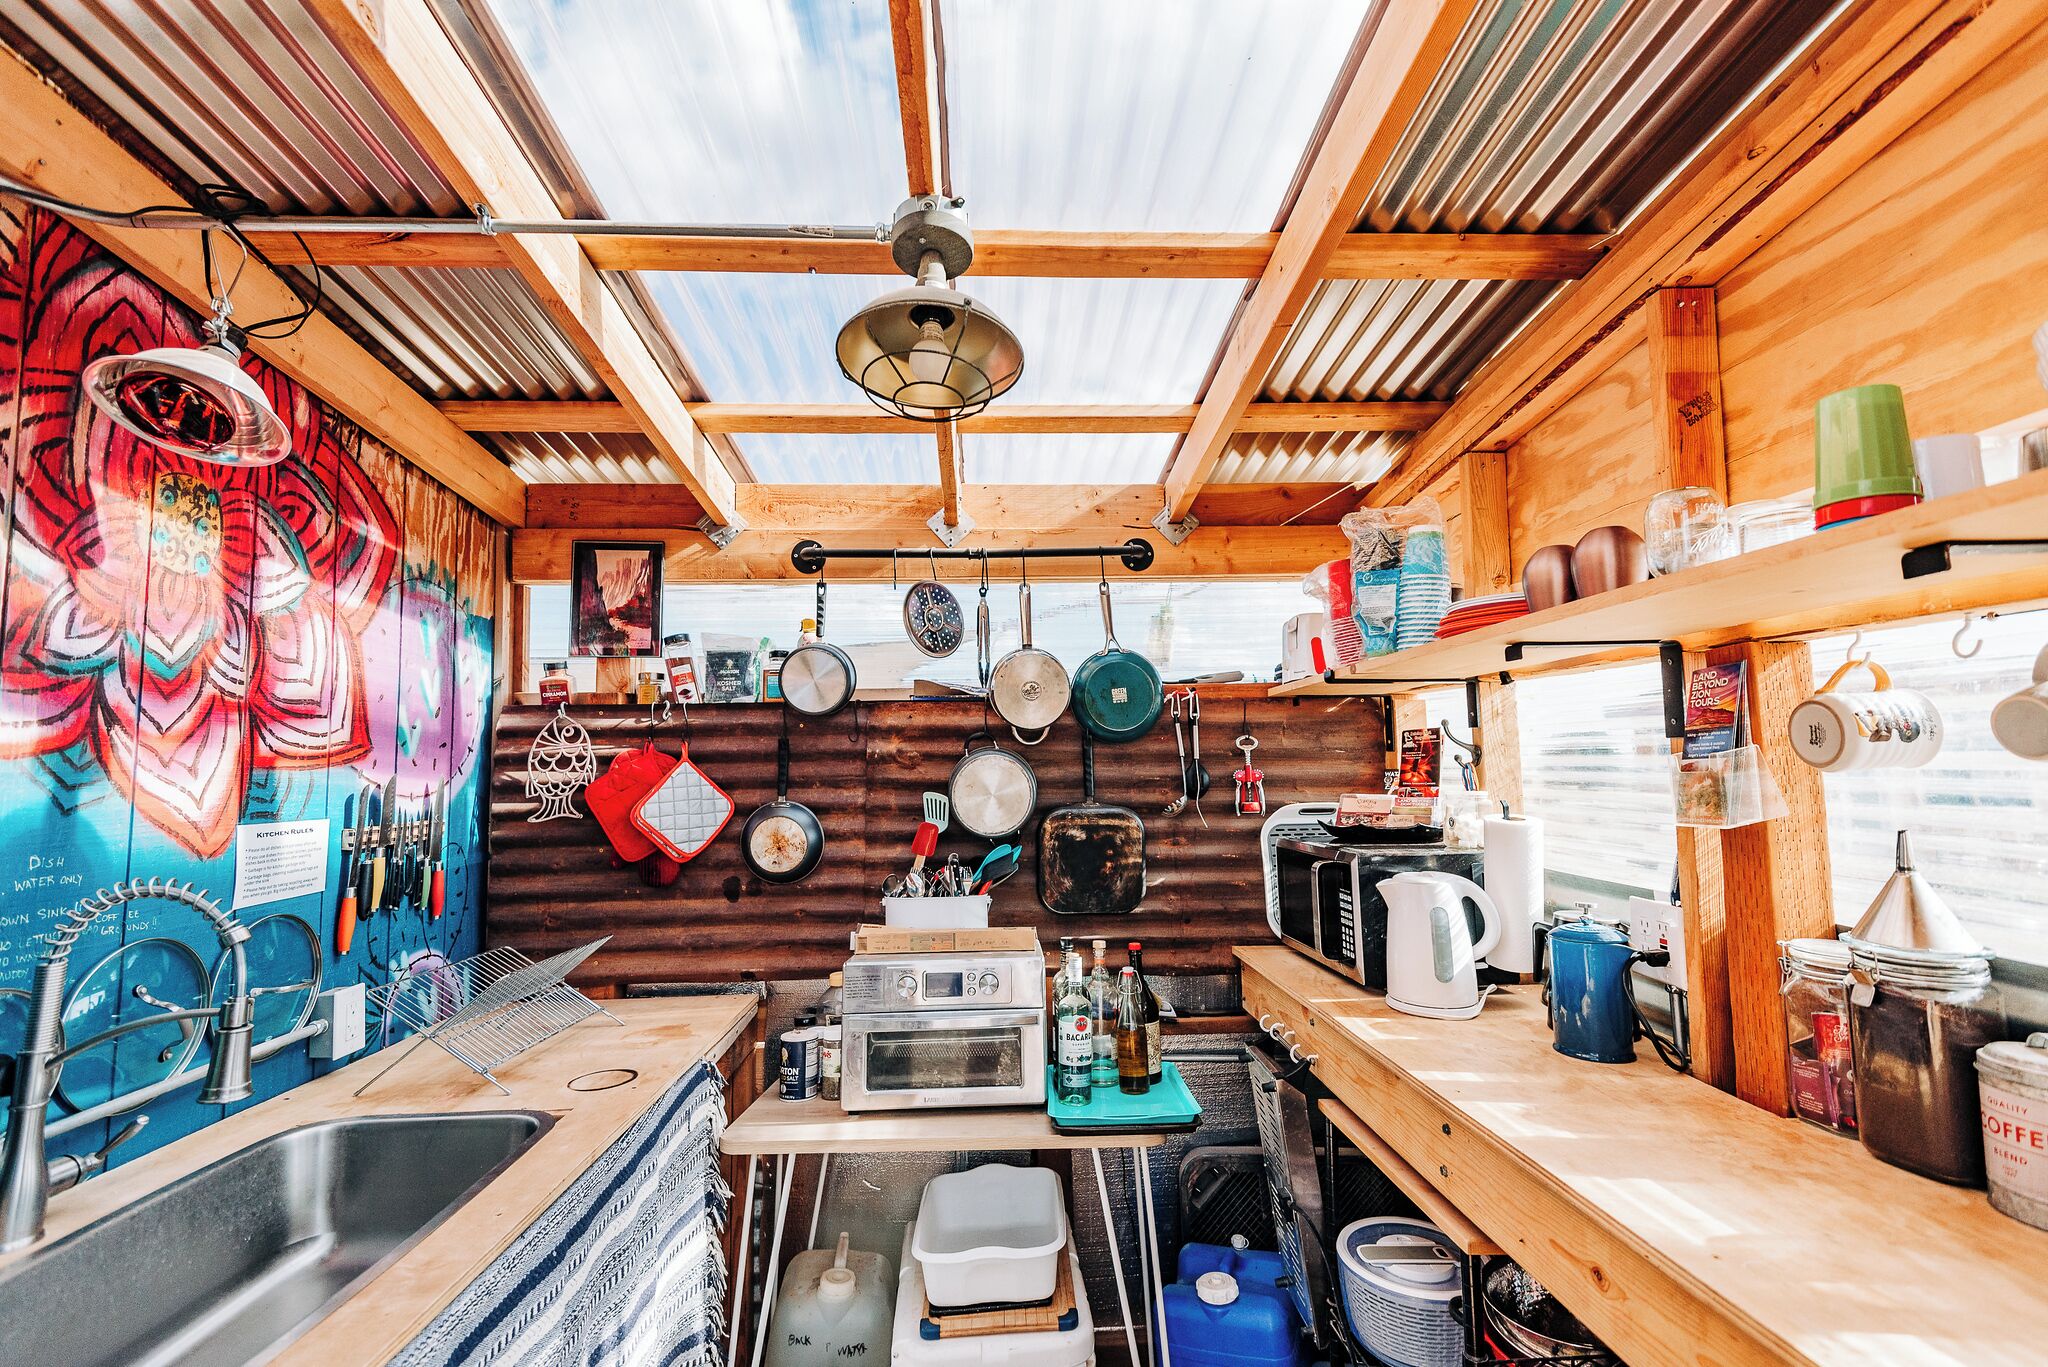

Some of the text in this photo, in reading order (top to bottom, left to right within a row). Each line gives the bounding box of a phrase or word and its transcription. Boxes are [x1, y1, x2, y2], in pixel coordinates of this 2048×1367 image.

[1692, 677, 1729, 691] BEYOND
[1693, 671, 1717, 682] LAND
[1690, 696, 1720, 708] TOURS
[1691, 689, 1711, 700] ZION
[256, 827, 314, 839] KITCHEN RULES
[29, 854, 65, 871] DISH
[14, 873, 83, 892] WATER ONLY
[0, 913, 30, 927] OWN
[37, 906, 68, 920] SINK
[1066, 1032, 1091, 1041] BACARD
[1987, 1095, 2028, 1116] QUALITY
[1981, 1110, 2048, 1150] COFFE
[1993, 1146, 2028, 1166] BLEND
